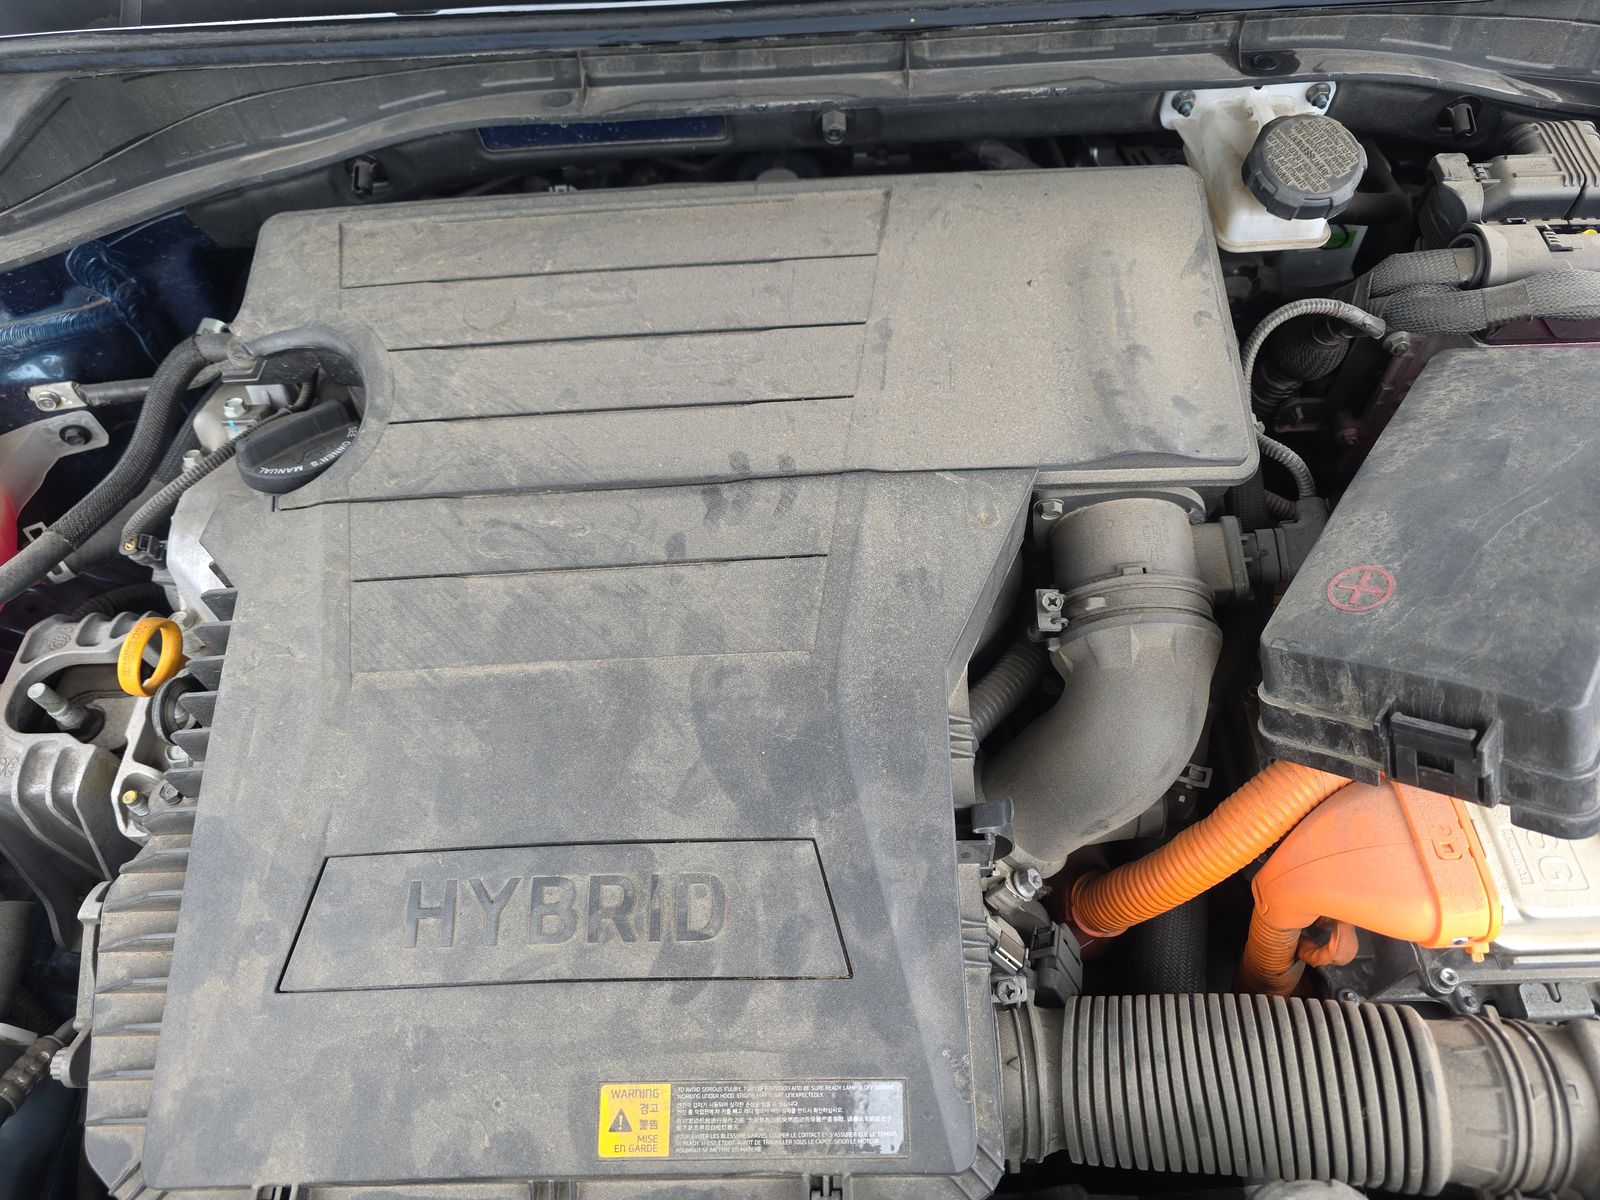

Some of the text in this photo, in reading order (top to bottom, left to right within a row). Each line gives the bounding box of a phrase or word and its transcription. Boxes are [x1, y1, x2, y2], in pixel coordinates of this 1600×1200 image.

[1287, 132, 1331, 176] AVERTISSEMENT
[1263, 156, 1294, 185] WARNING
[310, 440, 351, 467] OWNER'S
[260, 465, 303, 474] MANUAL
[401, 871, 726, 949] HYBRID
[611, 1088, 659, 1099] WARNING
[640, 1103, 659, 1115] 경고
[640, 1119, 659, 1131] 警告
[637, 1134, 659, 1144] MISE
[614, 1144, 659, 1153] EN GARDE
